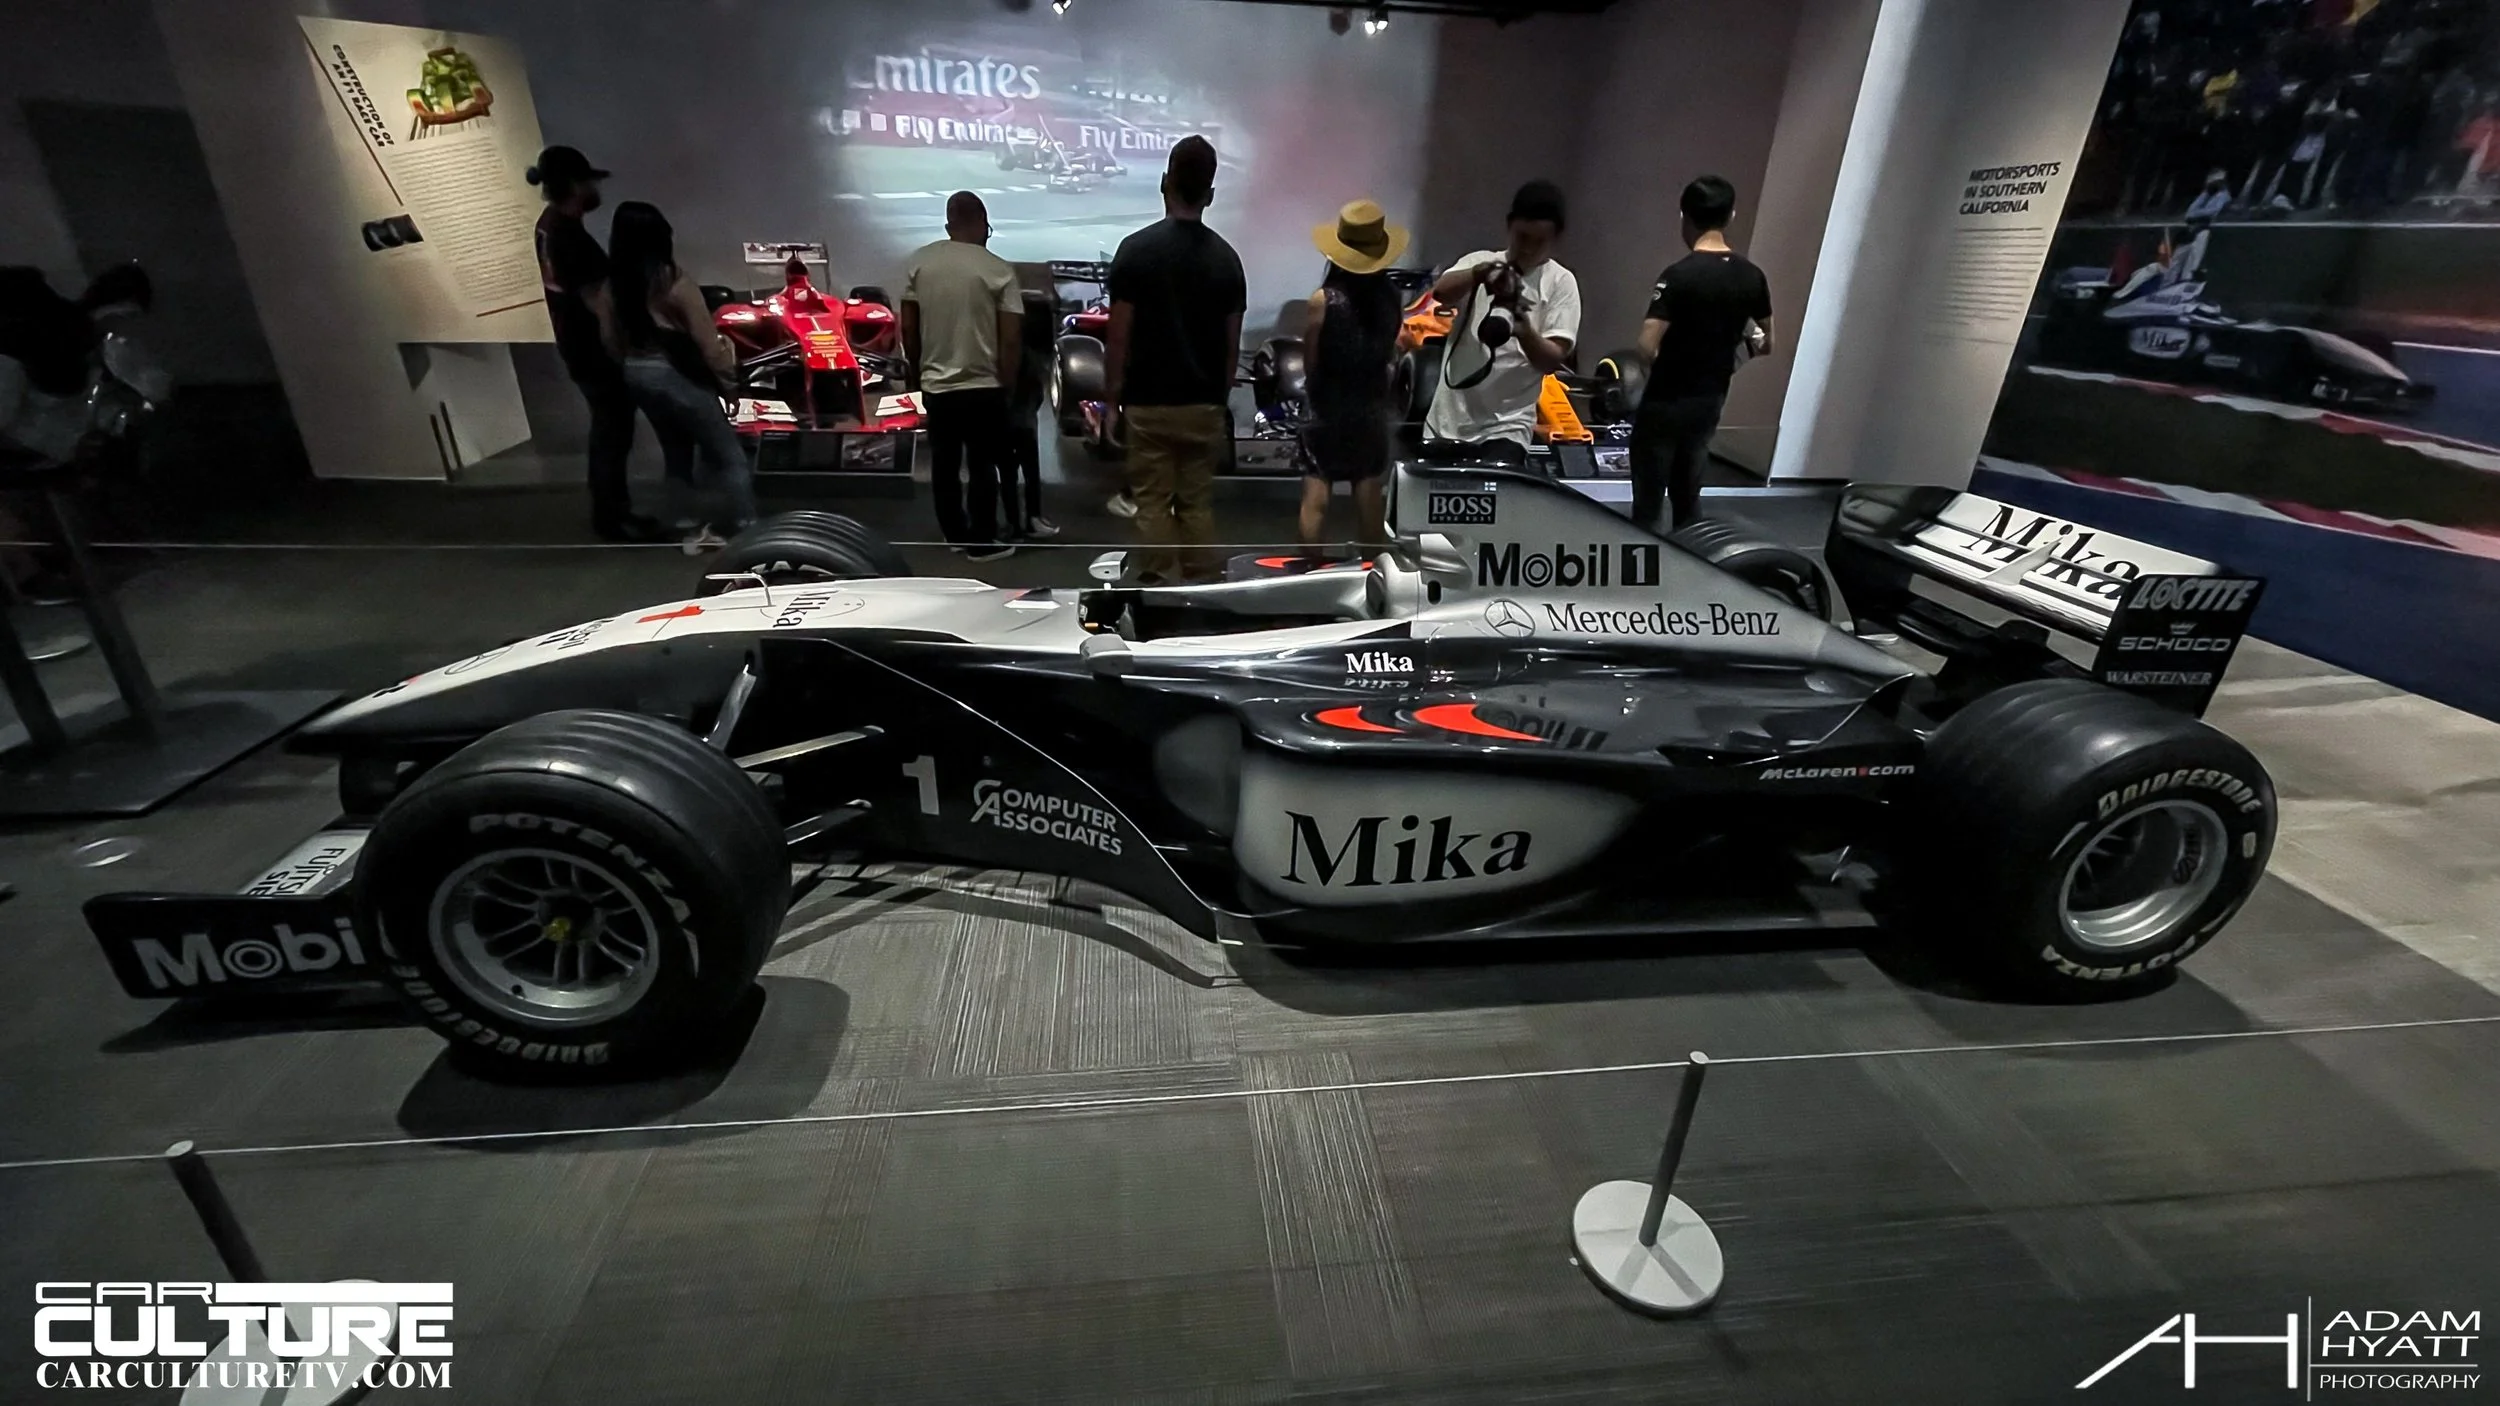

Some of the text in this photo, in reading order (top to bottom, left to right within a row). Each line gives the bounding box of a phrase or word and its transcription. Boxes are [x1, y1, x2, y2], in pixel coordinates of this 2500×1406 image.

[332, 63, 386, 147] AN F1 RACE CAR
[333, 44, 395, 145] CONSTRUCTION OF
[1079, 125, 1116, 153] Fly
[1963, 181, 2047, 200] IN SOUTHERN
[1969, 162, 2061, 182] MOTORSPORTS
[1959, 199, 2030, 215] CALIFORNIA
[1432, 496, 1493, 515] BOSS
[1477, 542, 1609, 588] Mobil
[2127, 576, 2259, 611] LOCTITE
[1543, 602, 1780, 637] Mercedes-Benz
[1344, 651, 1414, 674] Mika
[2105, 670, 2213, 686] WARSTEINER
[902, 754, 940, 816] 1
[2098, 768, 2263, 820] BRIDGESTONE
[970, 792, 1123, 856] ASSOCIATES
[973, 779, 1117, 833] COMPUTER
[469, 812, 692, 924] POTENZA
[1280, 810, 1532, 887] Mika
